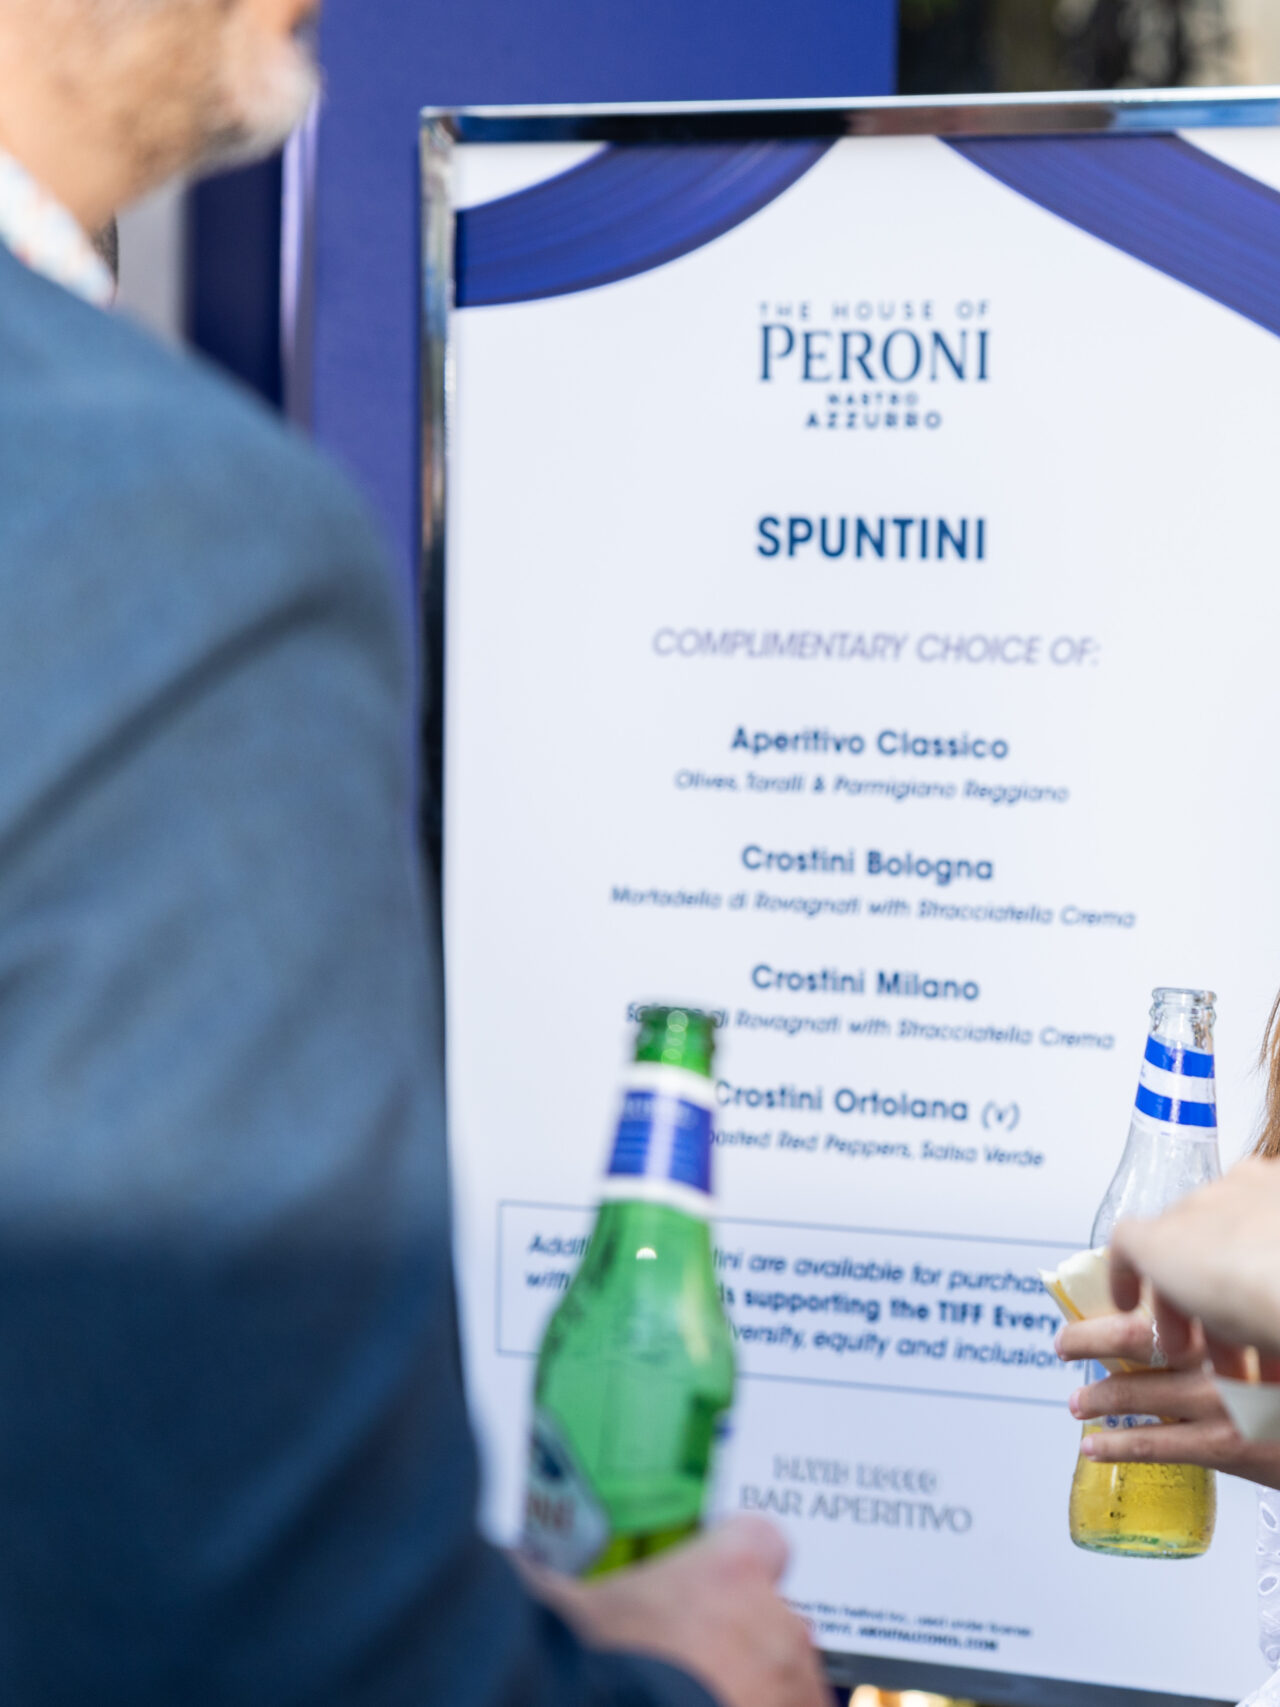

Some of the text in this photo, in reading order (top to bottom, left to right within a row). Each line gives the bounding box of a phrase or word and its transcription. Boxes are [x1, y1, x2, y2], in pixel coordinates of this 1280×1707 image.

[832, 300, 933, 321] HOUSE
[955, 299, 988, 321] OF
[759, 322, 991, 384] PERONI
[805, 411, 943, 430] AZZURRO
[755, 515, 986, 561] SPUNTINI
[652, 628, 908, 662] COMPLIMENTARY
[915, 633, 1042, 666] CHOICE
[730, 725, 1011, 760] Aperitivo Classico
[834, 774, 957, 802] Parmigiano
[964, 778, 1070, 806] Reggiano
[740, 845, 994, 886] Crostini Bologna
[867, 899, 911, 919] with
[1060, 904, 1136, 928] Crema
[751, 964, 981, 1001] Crostini Milano
[1039, 1025, 1115, 1050] Crema
[715, 1079, 824, 1110] Crostini
[834, 1088, 969, 1122] Ortolana
[777, 1130, 819, 1151] Red
[982, 1144, 1044, 1166] Verde
[748, 1254, 786, 1274] are
[794, 1254, 904, 1283] available
[912, 1264, 941, 1286] for
[945, 1267, 1047, 1297] purchas
[744, 1290, 883, 1322] supporting
[889, 1297, 929, 1321] the
[938, 1301, 984, 1325] TIFF
[993, 1305, 1062, 1337] Every
[812, 1330, 891, 1359] equity
[897, 1337, 947, 1359] and
[808, 1490, 975, 1534] APERITIVO
